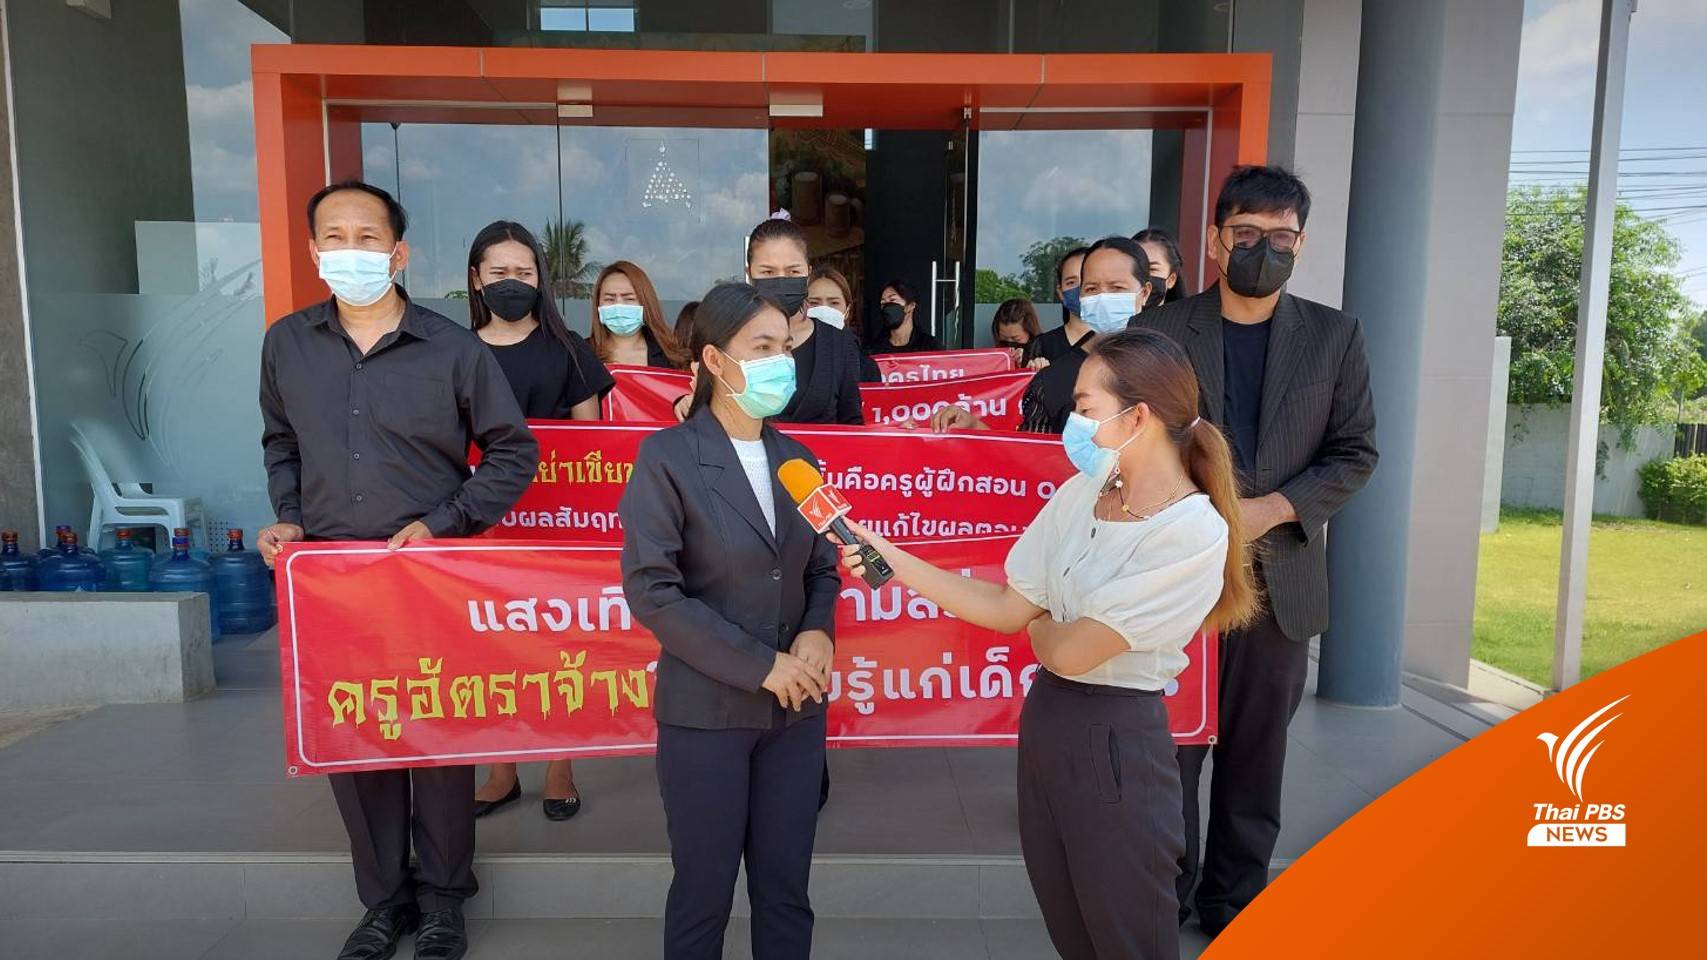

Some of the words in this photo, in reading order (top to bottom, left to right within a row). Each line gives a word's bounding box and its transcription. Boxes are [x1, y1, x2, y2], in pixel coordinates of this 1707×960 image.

[327, 650, 658, 740] ครูอัตราจ้าง
